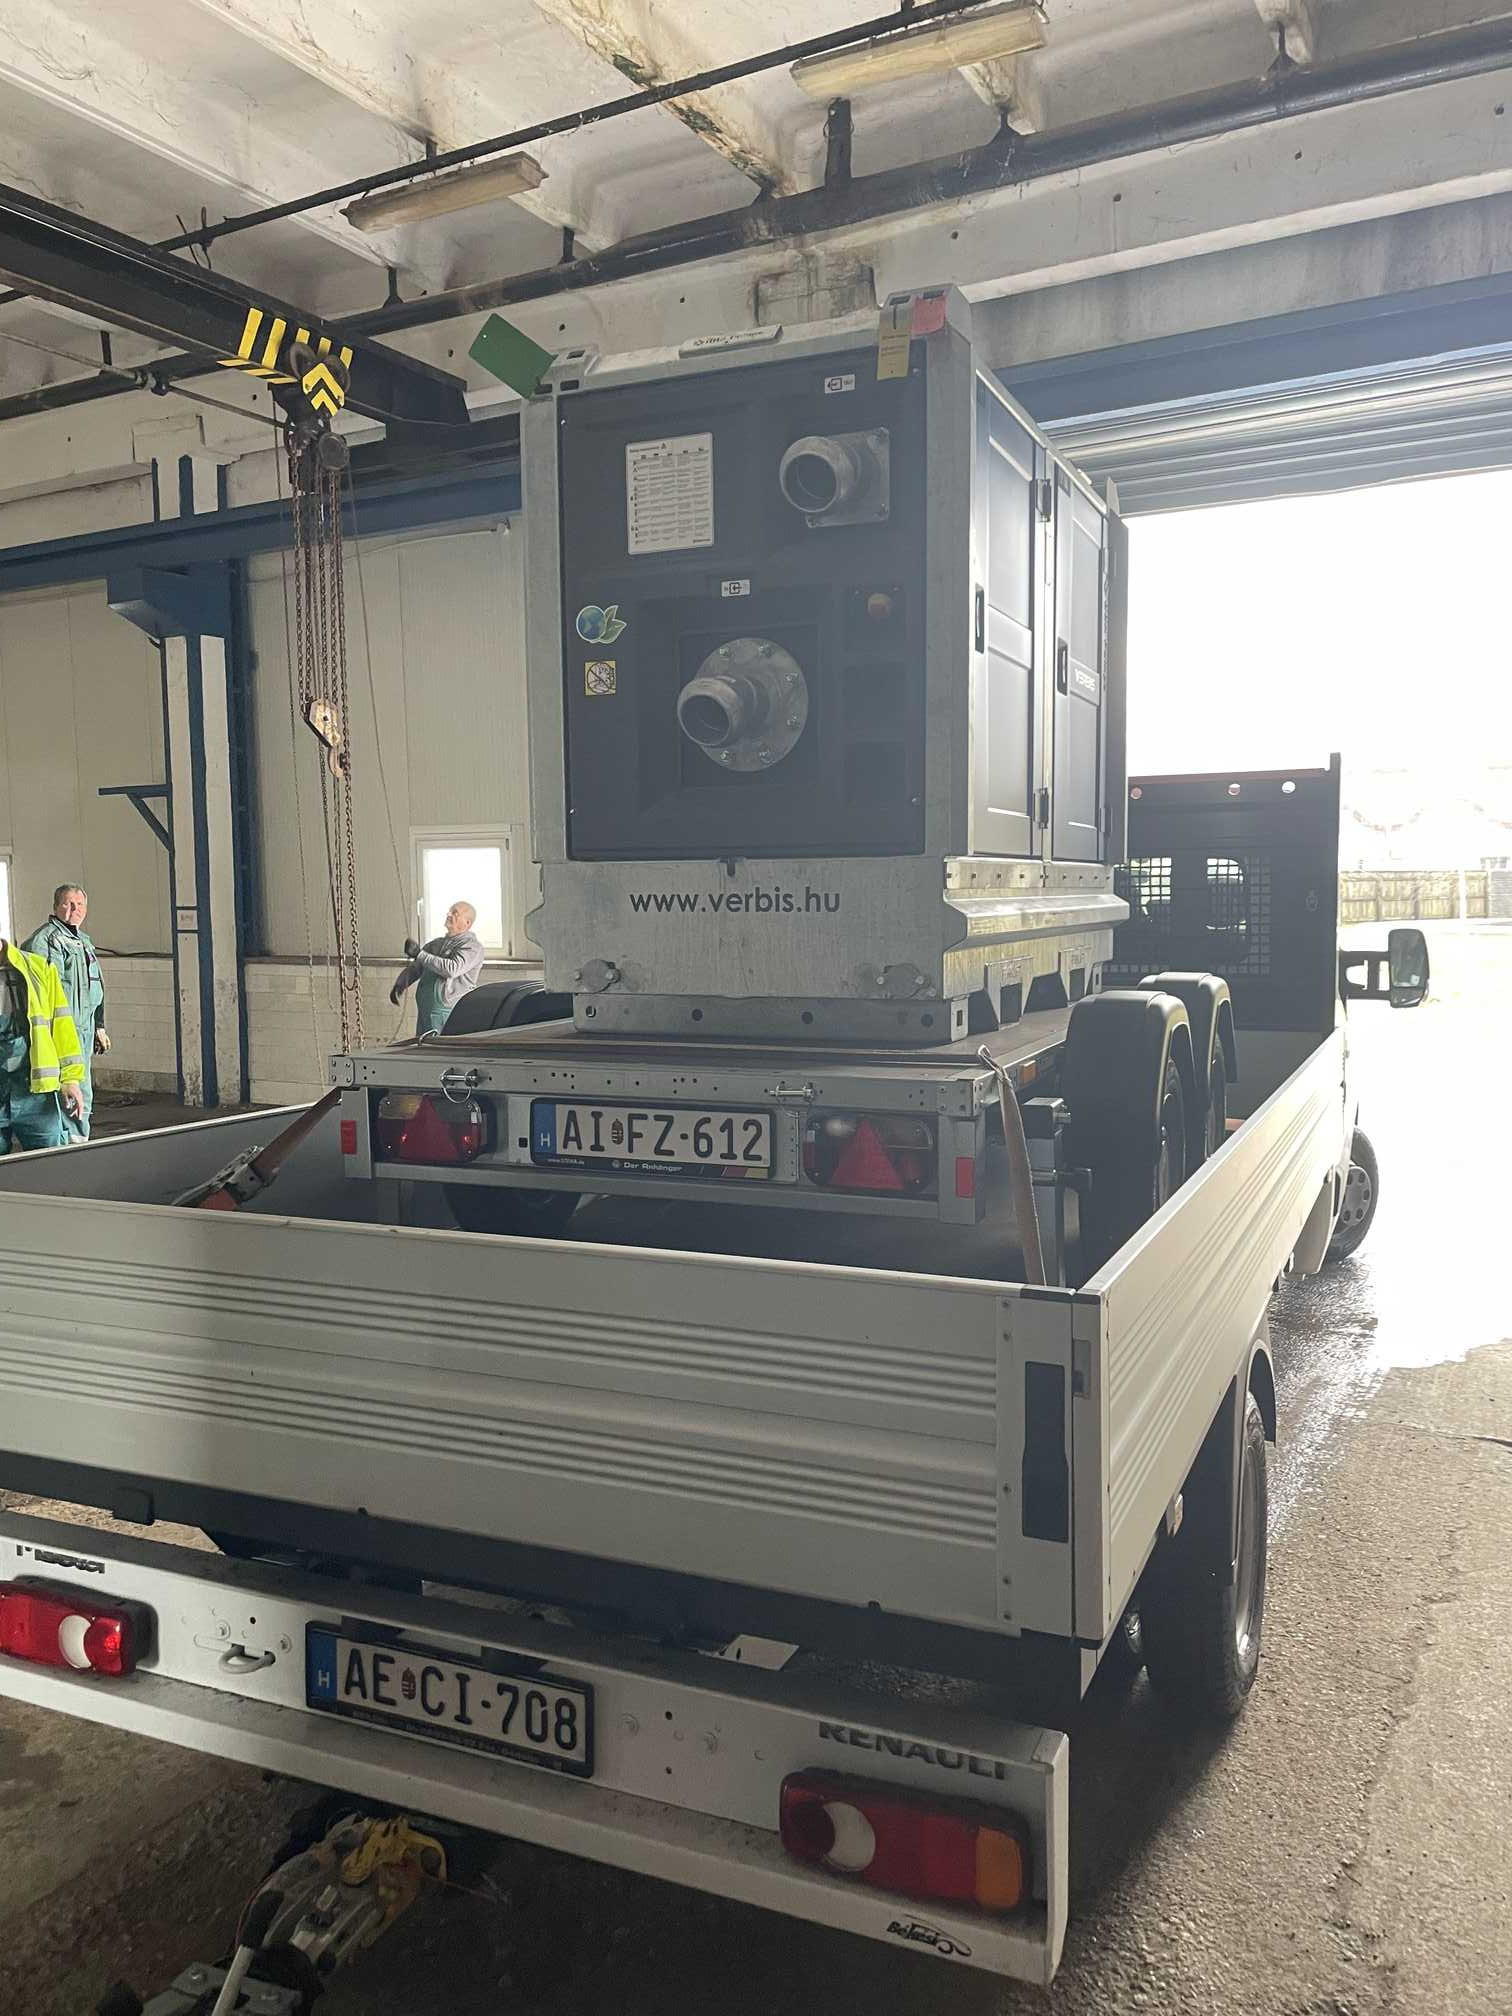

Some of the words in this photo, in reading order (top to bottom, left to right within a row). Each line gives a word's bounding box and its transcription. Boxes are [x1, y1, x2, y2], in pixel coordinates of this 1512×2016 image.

[629, 886, 840, 913] www.verbis.hu
[540, 1132, 551, 1148] H
[317, 1669, 331, 1689] H
